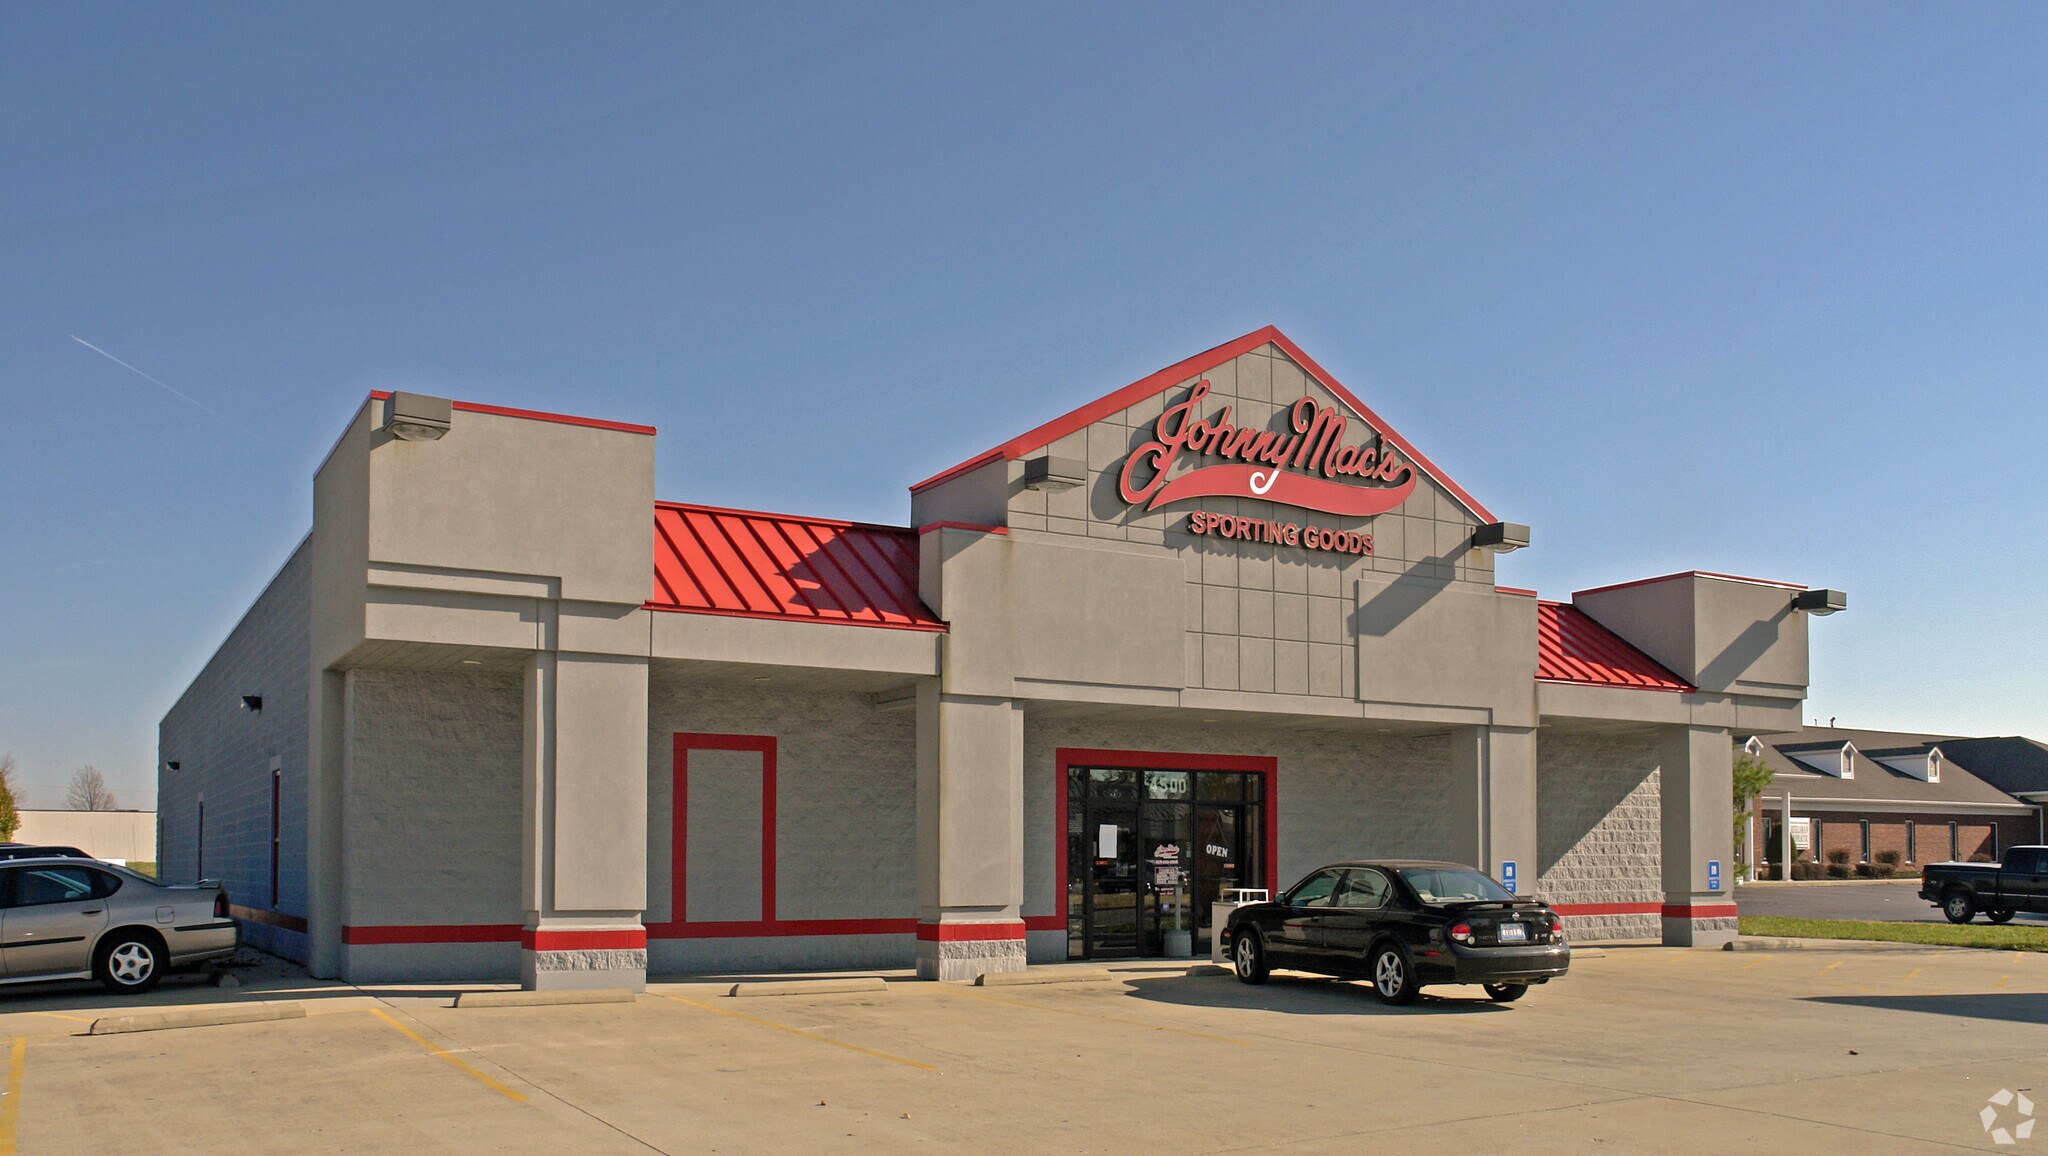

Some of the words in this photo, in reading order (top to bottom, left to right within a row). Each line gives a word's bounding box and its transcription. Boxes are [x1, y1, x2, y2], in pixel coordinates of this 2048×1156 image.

[1116, 379, 1298, 505] Johnny
[1289, 396, 1398, 482] Mac's
[1191, 511, 1299, 547] SPORTING
[1303, 525, 1374, 557] GOODS
[1206, 844, 1229, 858] OPEN
